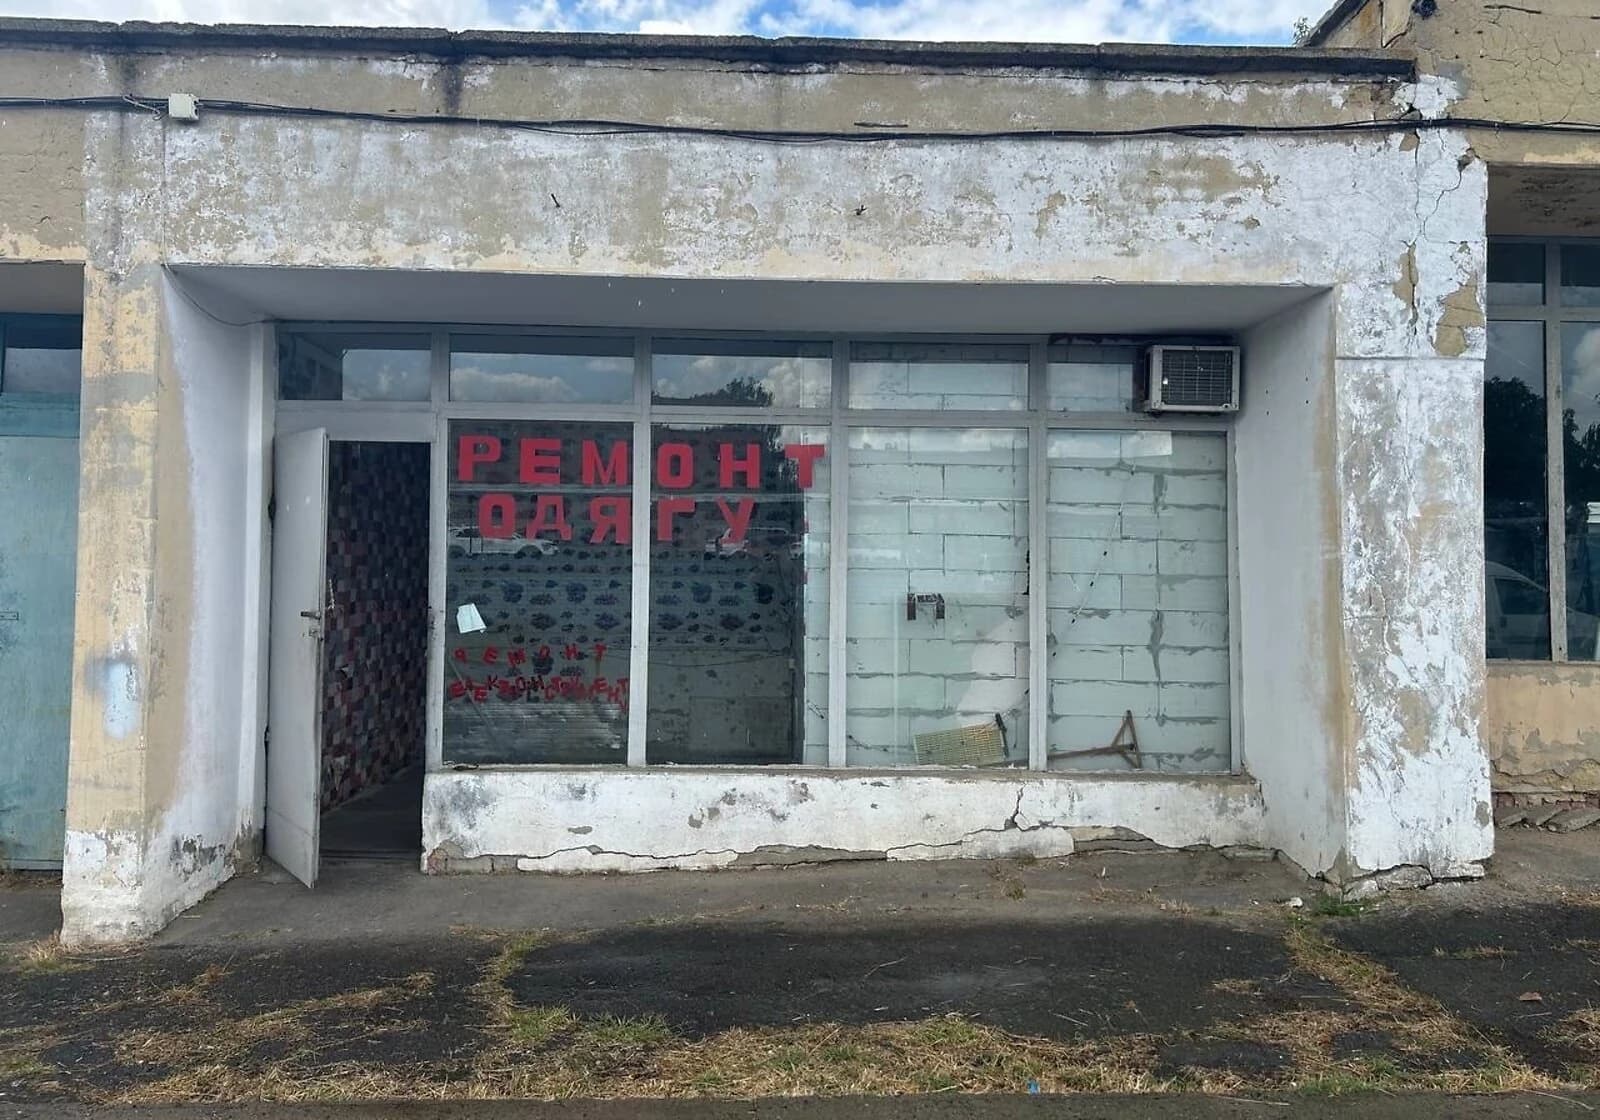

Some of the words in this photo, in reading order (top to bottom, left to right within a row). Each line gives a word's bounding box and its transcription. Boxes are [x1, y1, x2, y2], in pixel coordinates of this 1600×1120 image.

[458, 436, 825, 488] РЕМОНТ
[478, 493, 756, 543] ОДЯГУ
[454, 644, 607, 665] РЕМОНТ
